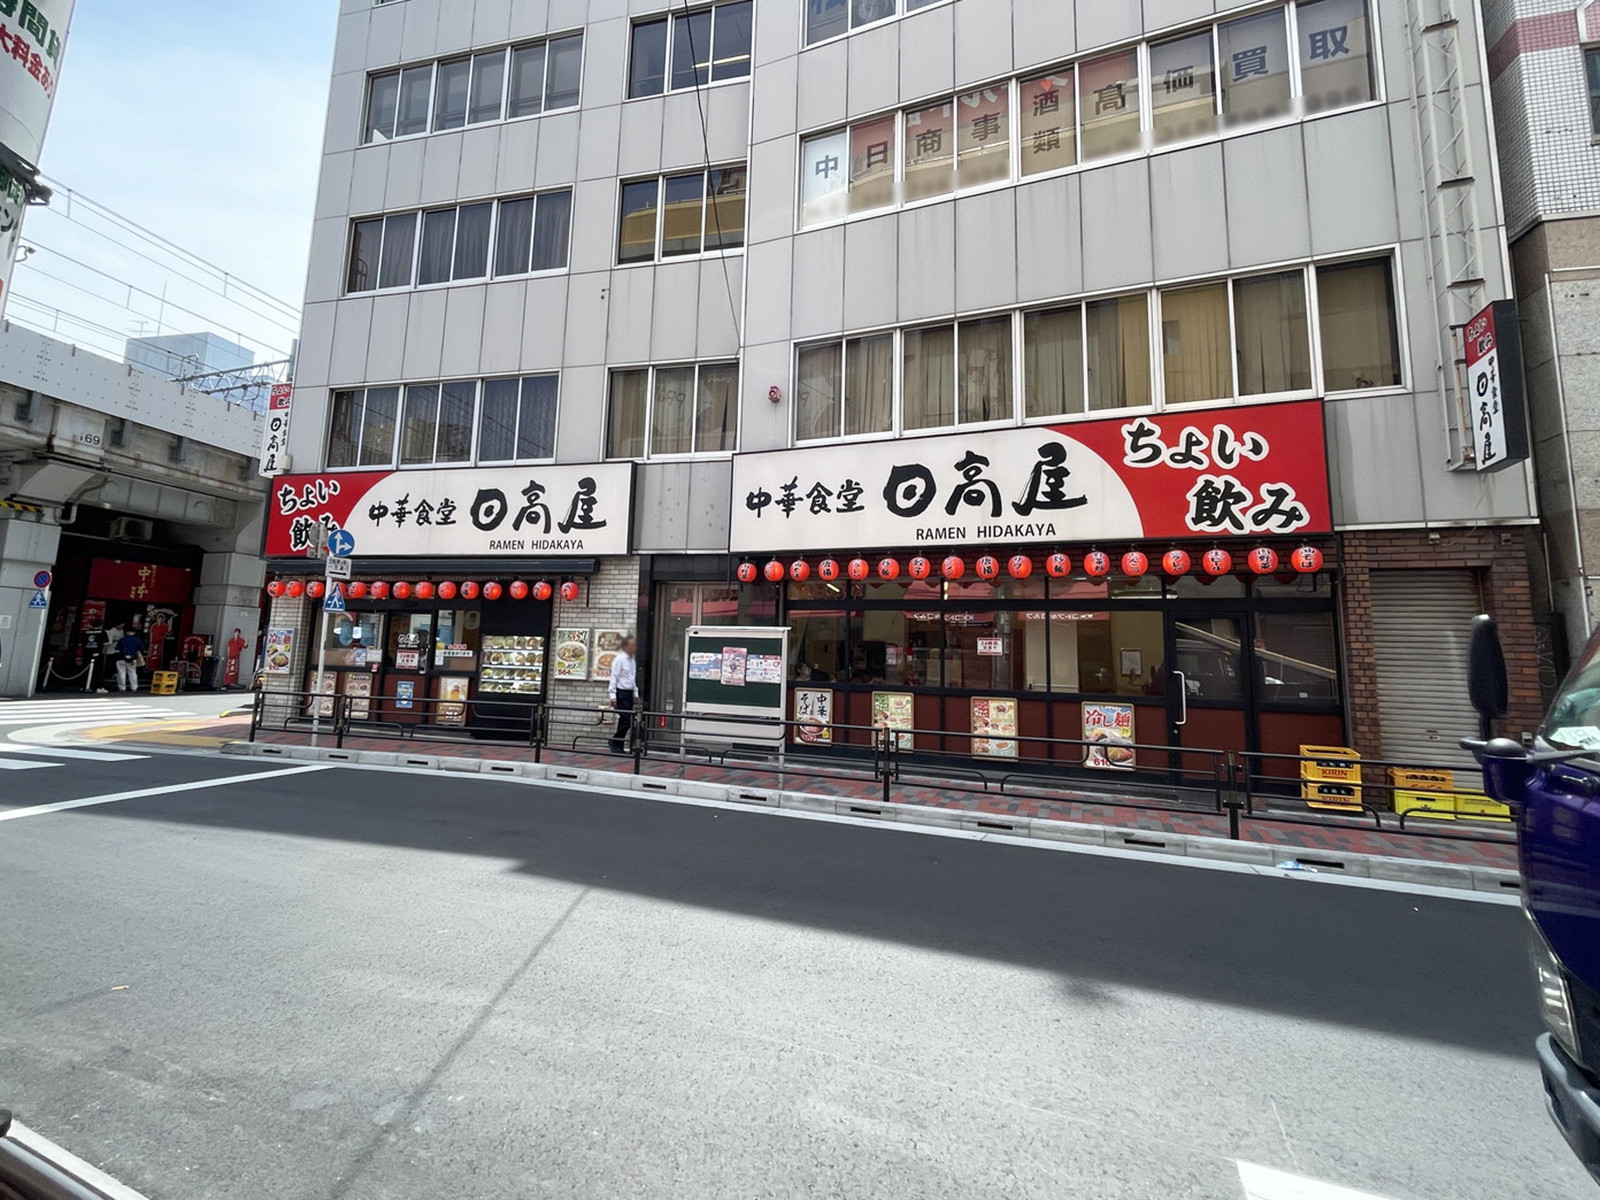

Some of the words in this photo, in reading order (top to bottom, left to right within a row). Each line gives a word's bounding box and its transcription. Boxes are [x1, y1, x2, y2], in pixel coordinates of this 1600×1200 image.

[1033, 89, 1061, 155] 酒類
[1476, 371, 1497, 466] 日高屋
[1124, 420, 1266, 467] ちょい
[278, 480, 340, 514] ちょい
[746, 475, 865, 519] 中華食堂
[883, 441, 1088, 518] 日高屋
[369, 492, 457, 528] 中華食堂
[470, 476, 607, 534] 日高屋
[1188, 477, 1306, 533] 飲み
[490, 540, 524, 550] RAMEN
[531, 539, 584, 550] HIDAKAYA
[916, 526, 966, 540] RAMEN
[977, 522, 1056, 539] HIDAKAYA
[799, 692, 810, 716] そば
[817, 693, 828, 717] 中華
[1085, 709, 1130, 728] 冷し麺
[1322, 768, 1348, 777] KIRIN
